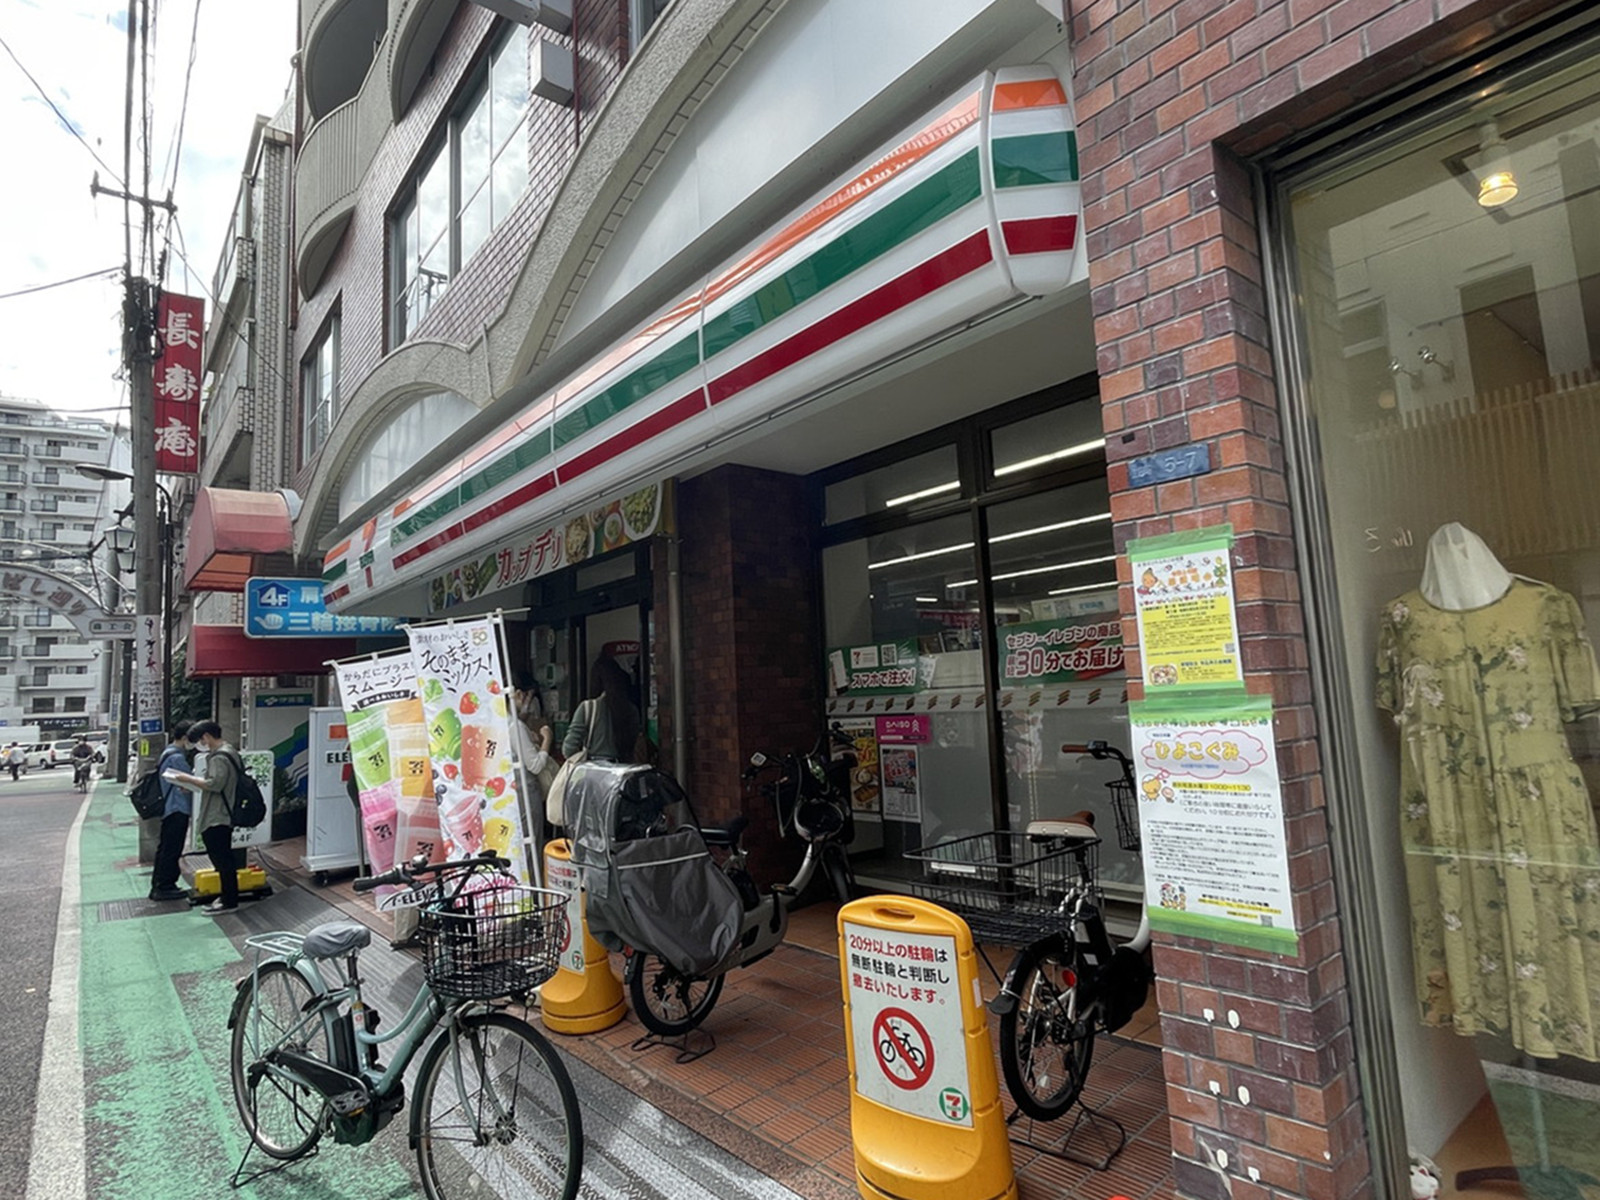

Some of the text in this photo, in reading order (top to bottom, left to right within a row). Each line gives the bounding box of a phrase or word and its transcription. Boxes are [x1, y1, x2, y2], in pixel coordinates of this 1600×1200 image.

[497, 529, 563, 588] カップデリ
[260, 587, 288, 606] 4F
[420, 640, 478, 673] そのまま
[346, 674, 416, 696] スムージー
[852, 668, 916, 688] スマホで注文!
[1154, 741, 1240, 760] ひよこぐみ
[849, 932, 947, 963] 20分以上の駐輪は
[851, 953, 950, 985] 無断駐輪と判断し
[852, 973, 946, 1005] 撤去いたします。
